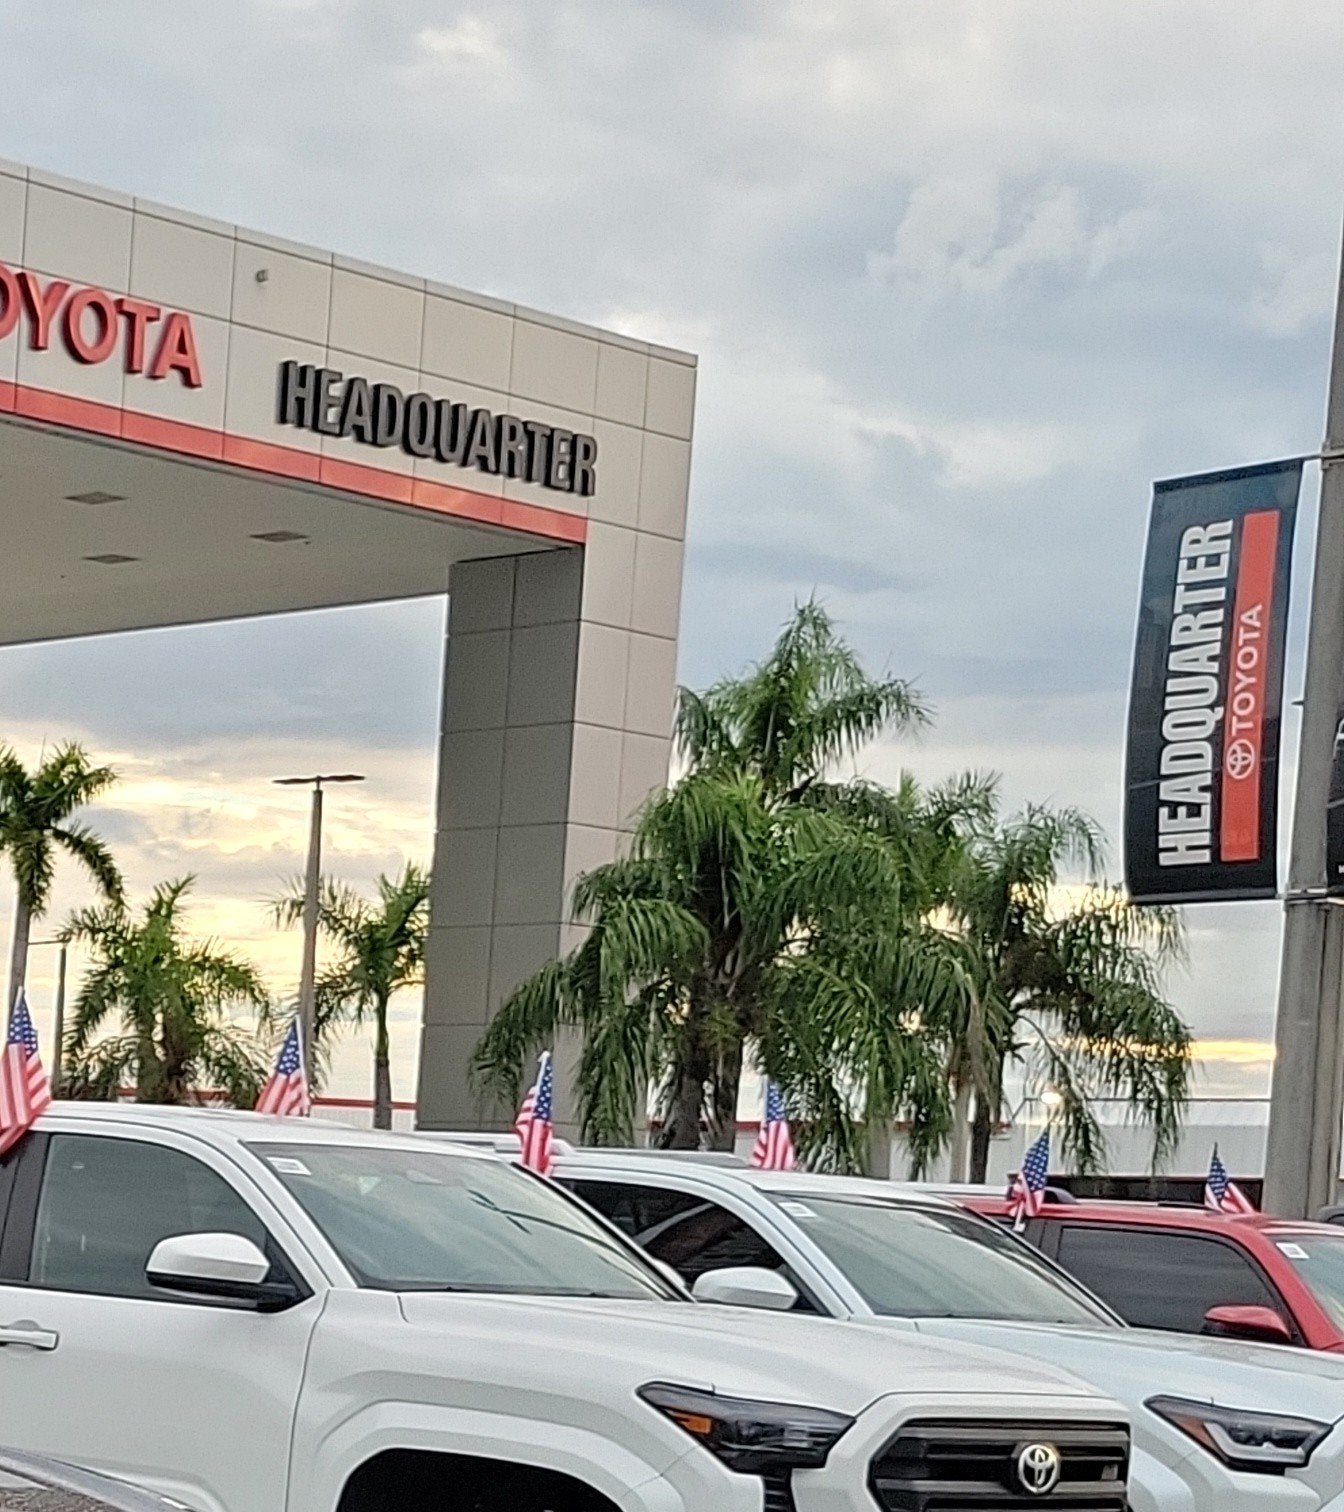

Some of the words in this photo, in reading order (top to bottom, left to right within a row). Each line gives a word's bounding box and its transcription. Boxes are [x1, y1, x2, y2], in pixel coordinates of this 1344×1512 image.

[274, 360, 598, 497] HEADQUARTER
[1158, 519, 1234, 867] HEADQUARTER
[1231, 604, 1263, 737] TOYOTA
